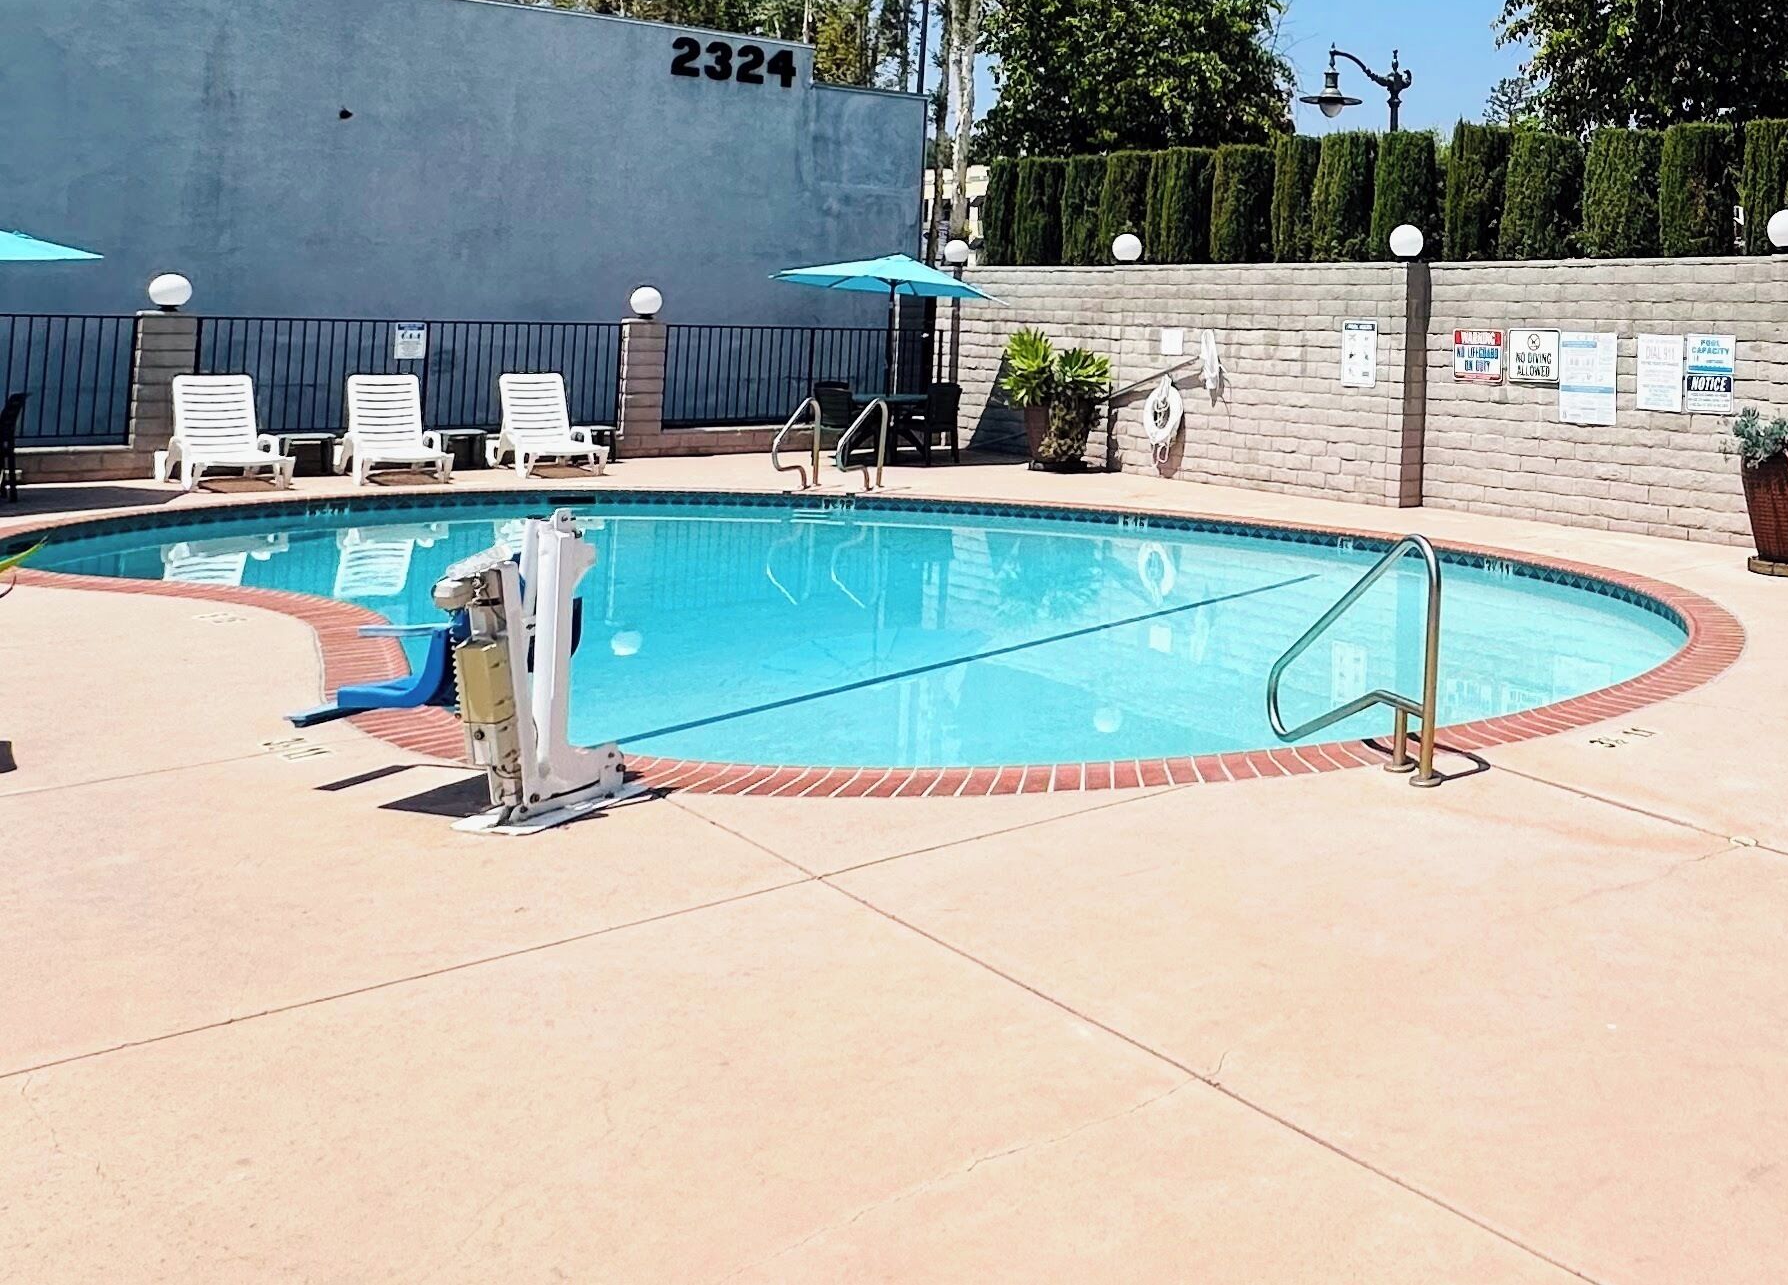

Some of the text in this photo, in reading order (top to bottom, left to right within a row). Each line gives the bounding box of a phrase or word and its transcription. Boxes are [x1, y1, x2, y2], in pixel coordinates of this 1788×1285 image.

[670, 36, 797, 89] 2324
[1460, 331, 1496, 345] WARNING
[1457, 347, 1499, 360] NO LIFEGUARD
[1691, 347, 1730, 355] CAPACITY
[1515, 352, 1552, 364] NO DIVING
[1464, 360, 1491, 372] ON DUTY
[1516, 365, 1550, 377] ALLOWED
[1690, 376, 1728, 392] NOTICE
